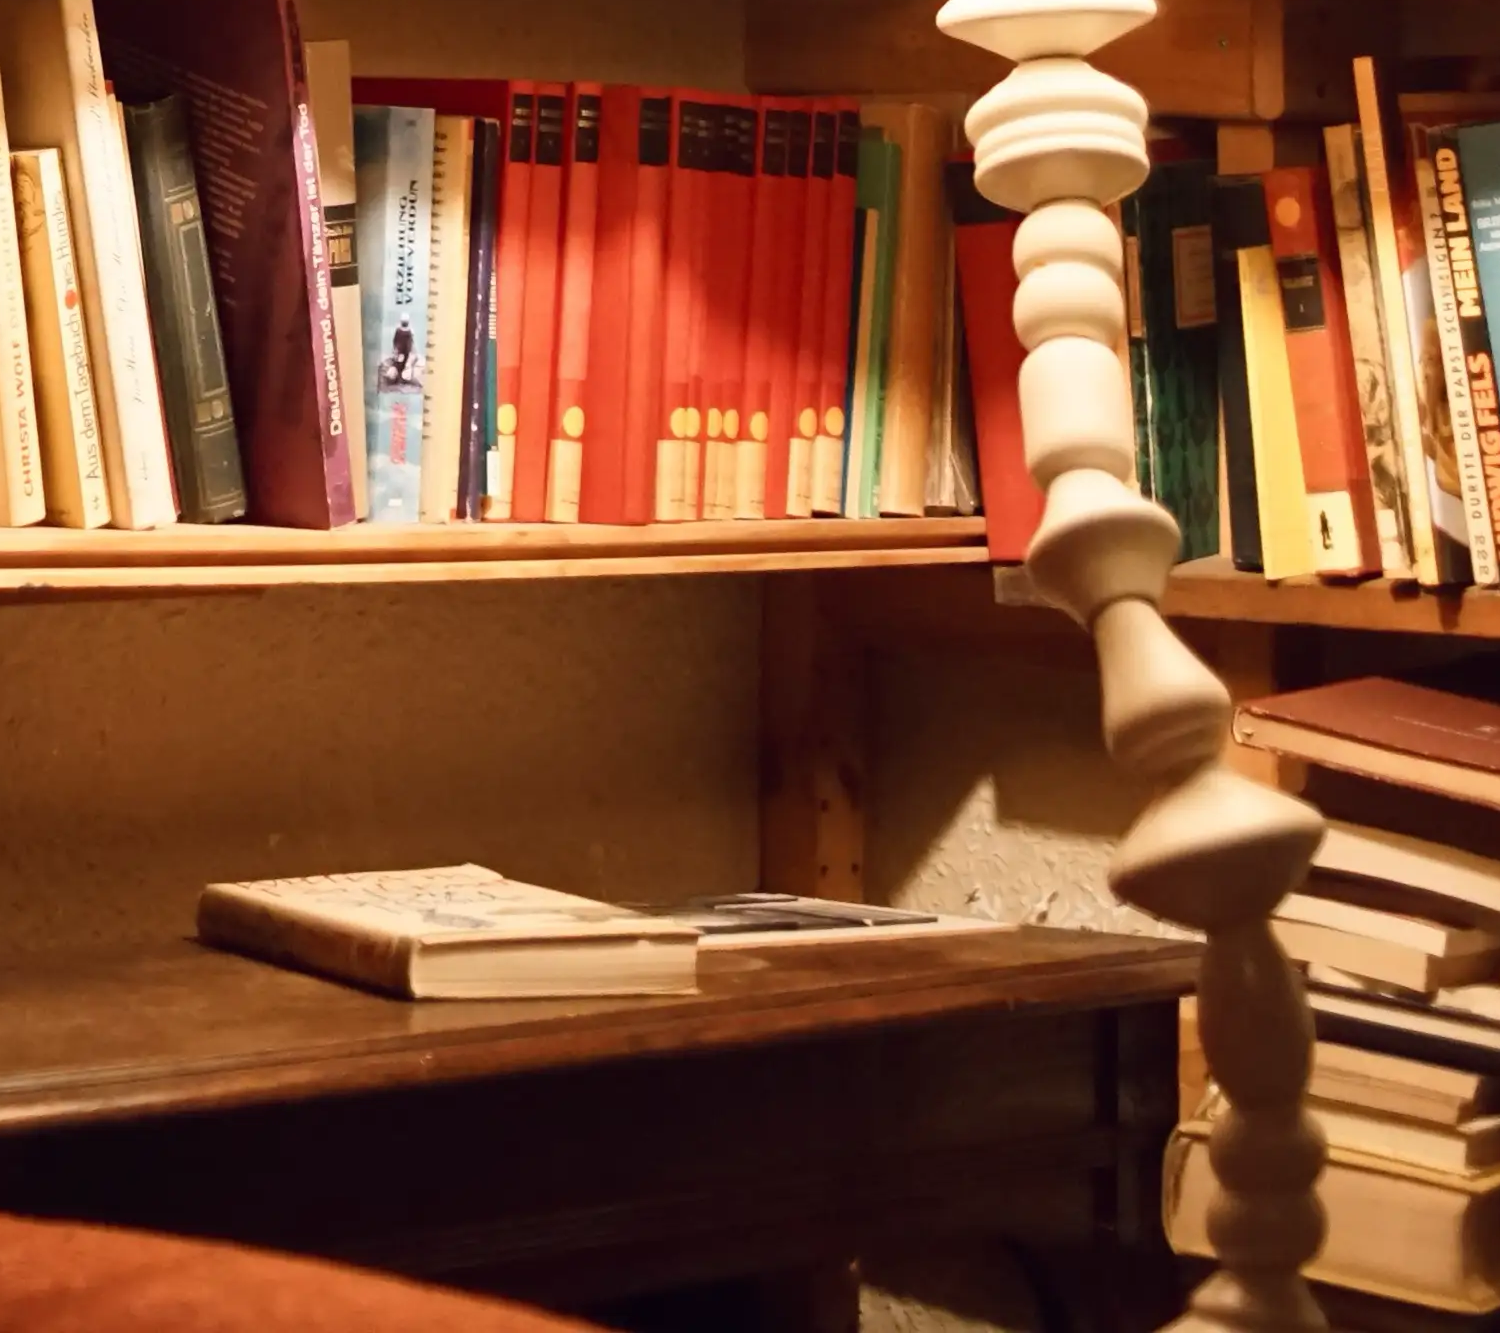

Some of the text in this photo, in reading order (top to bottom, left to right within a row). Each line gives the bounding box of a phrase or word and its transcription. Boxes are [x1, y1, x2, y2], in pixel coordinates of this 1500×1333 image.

[295, 103, 311, 138] Tod
[300, 141, 315, 174] der
[304, 178, 318, 201] ist
[306, 204, 325, 266] Tänzer
[394, 195, 409, 307] ERZIEHUNG
[403, 179, 418, 306] VOR VERDUN
[1434, 147, 1483, 319] MEIN LAND
[312, 269, 329, 310] dein
[49, 190, 101, 481] Aus dem Tagebuch Hundes
[9, 340, 27, 399] WOLF
[318, 313, 344, 438] Deutschland,
[1447, 344, 1469, 400] PAPST
[1466, 352, 1498, 427] FELS
[16, 406, 34, 498] CHRISTA
[1456, 408, 1473, 442] DER
